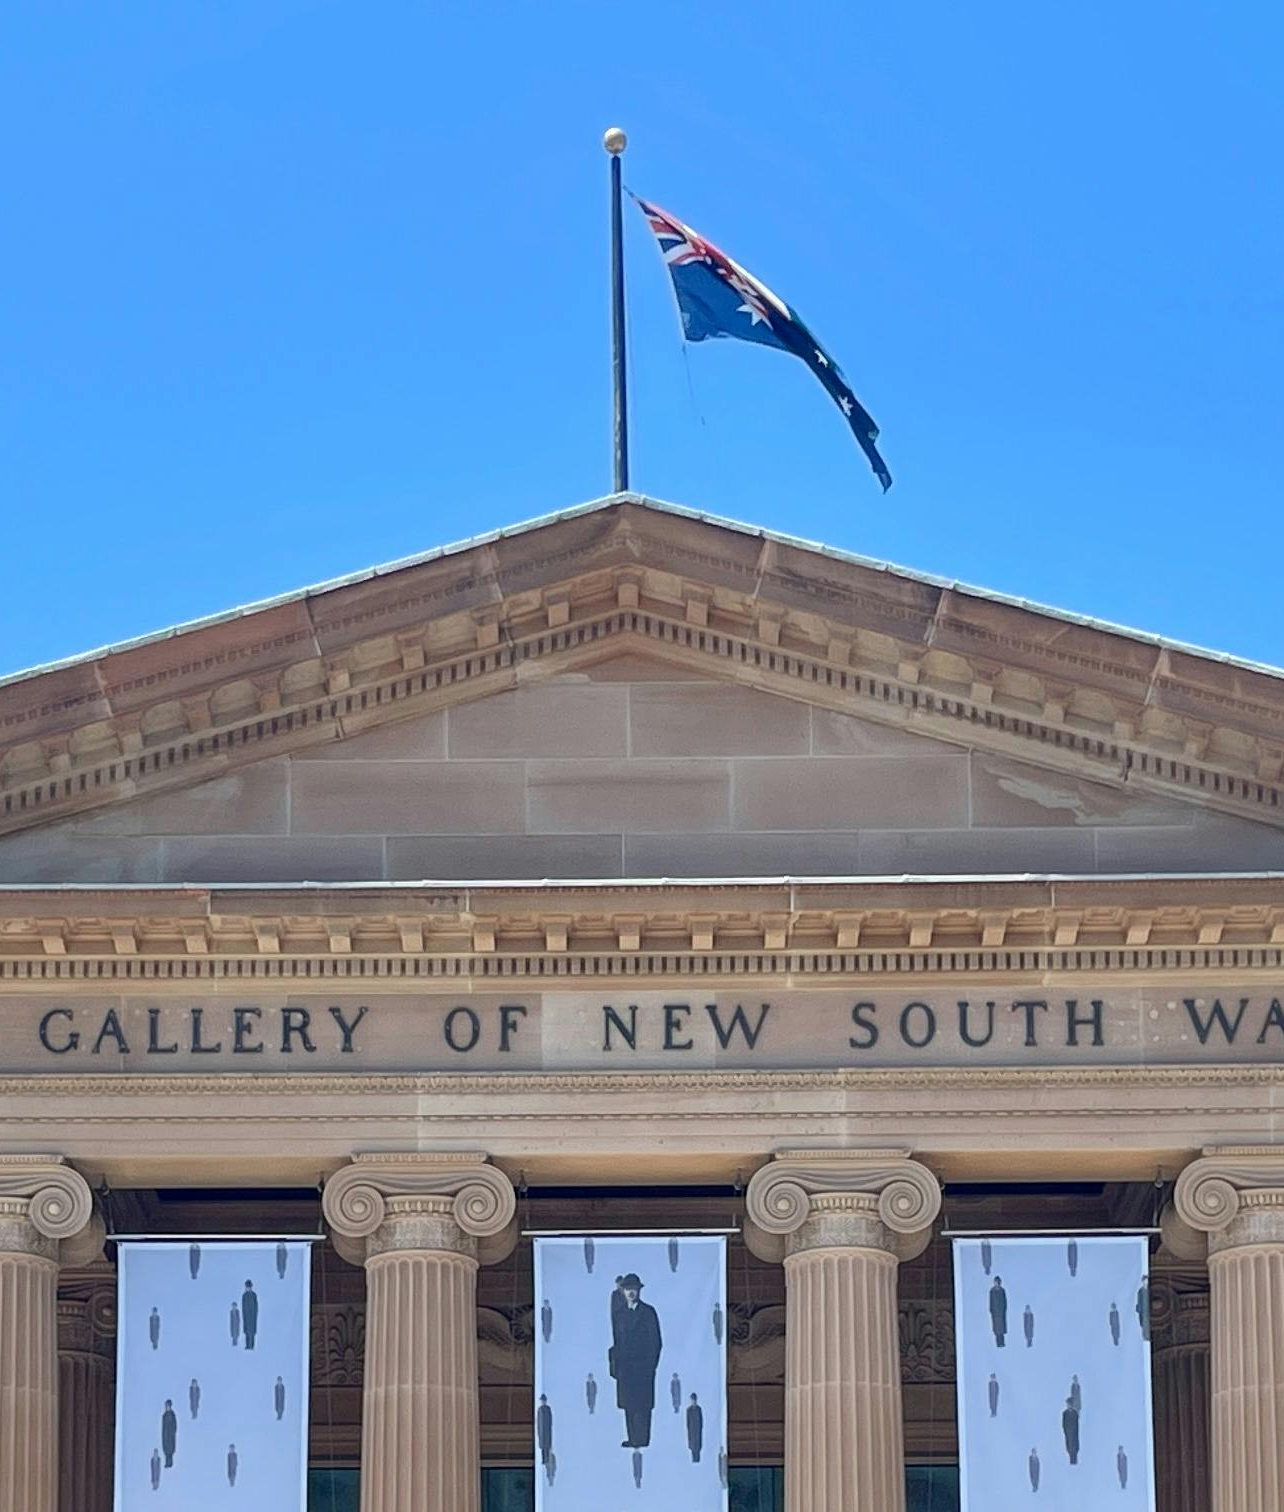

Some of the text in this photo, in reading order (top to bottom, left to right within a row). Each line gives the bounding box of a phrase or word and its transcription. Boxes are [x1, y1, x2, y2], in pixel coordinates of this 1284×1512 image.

[37, 1006, 370, 1055] GALLERY
[443, 1005, 528, 1054] OF
[601, 1002, 771, 1052] NEW
[848, 1000, 1106, 1050] SOUTH
